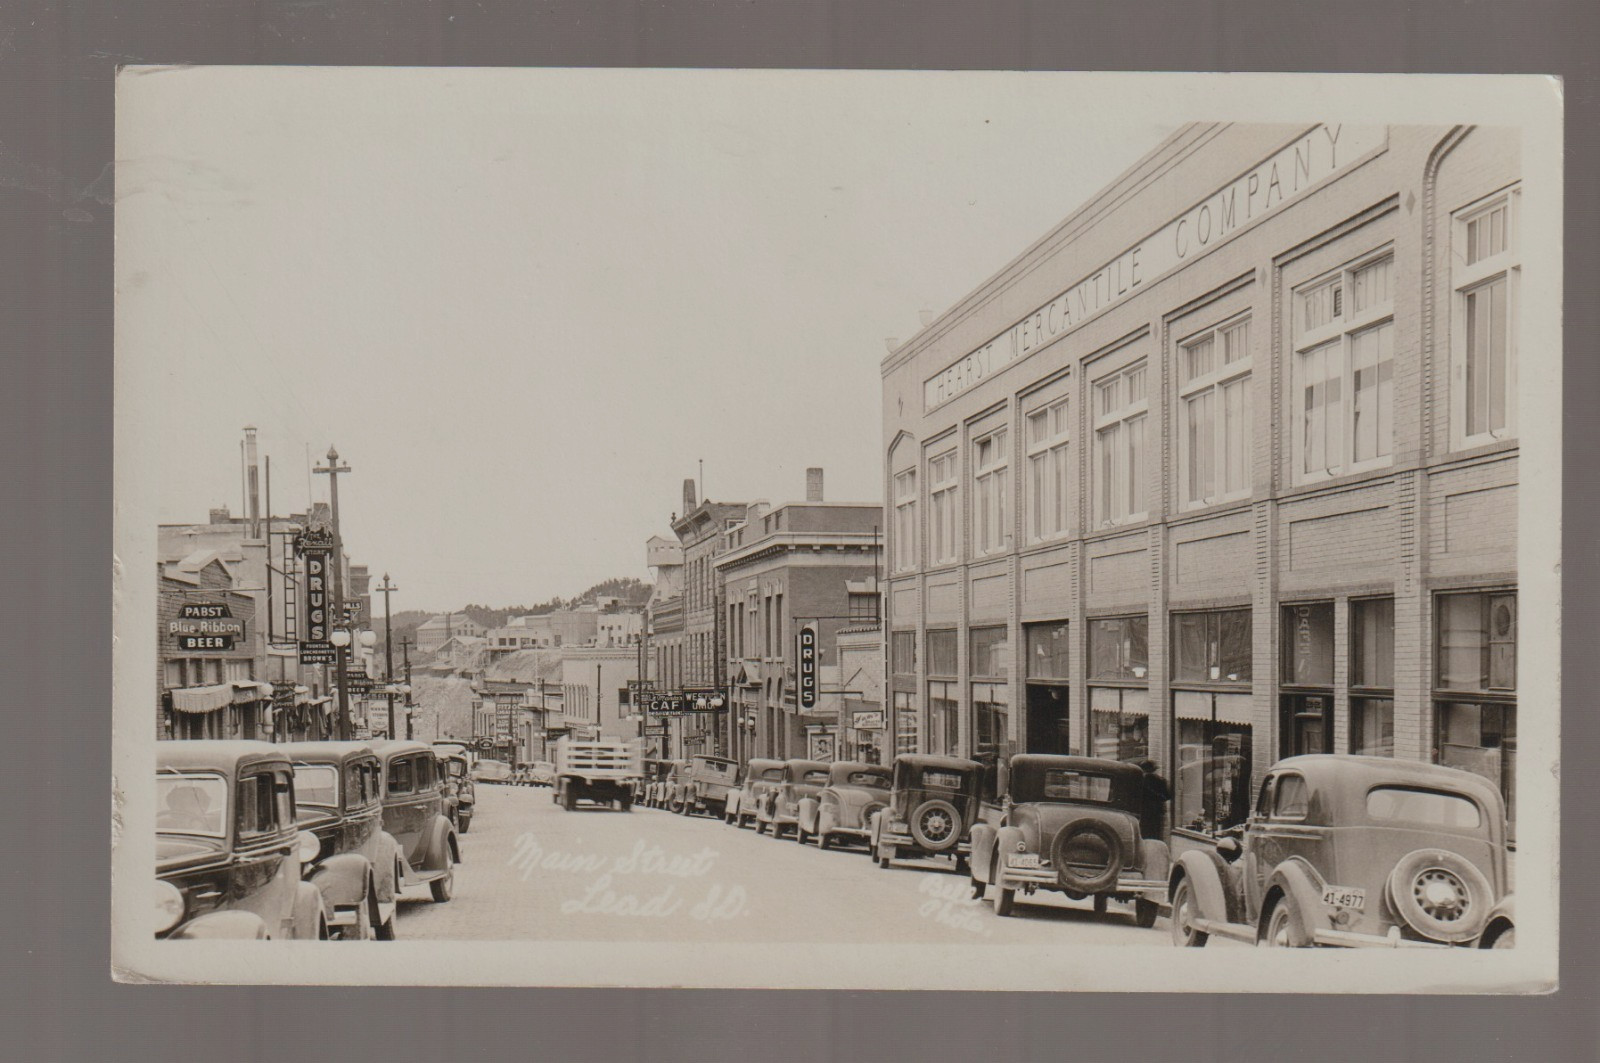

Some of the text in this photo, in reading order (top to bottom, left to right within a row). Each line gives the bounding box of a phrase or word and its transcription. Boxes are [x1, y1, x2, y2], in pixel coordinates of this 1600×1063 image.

[937, 122, 1342, 401] HEARST MERCANTILE COMPANY
[296, 537, 333, 549] Rexall
[309, 560, 324, 640] DRUGS
[185, 606, 224, 617] PABST
[169, 620, 241, 633] Blue Ribbon
[187, 637, 224, 648] BEER
[803, 634, 814, 701] DRUGS
[1323, 892, 1364, 908] 41-4977
